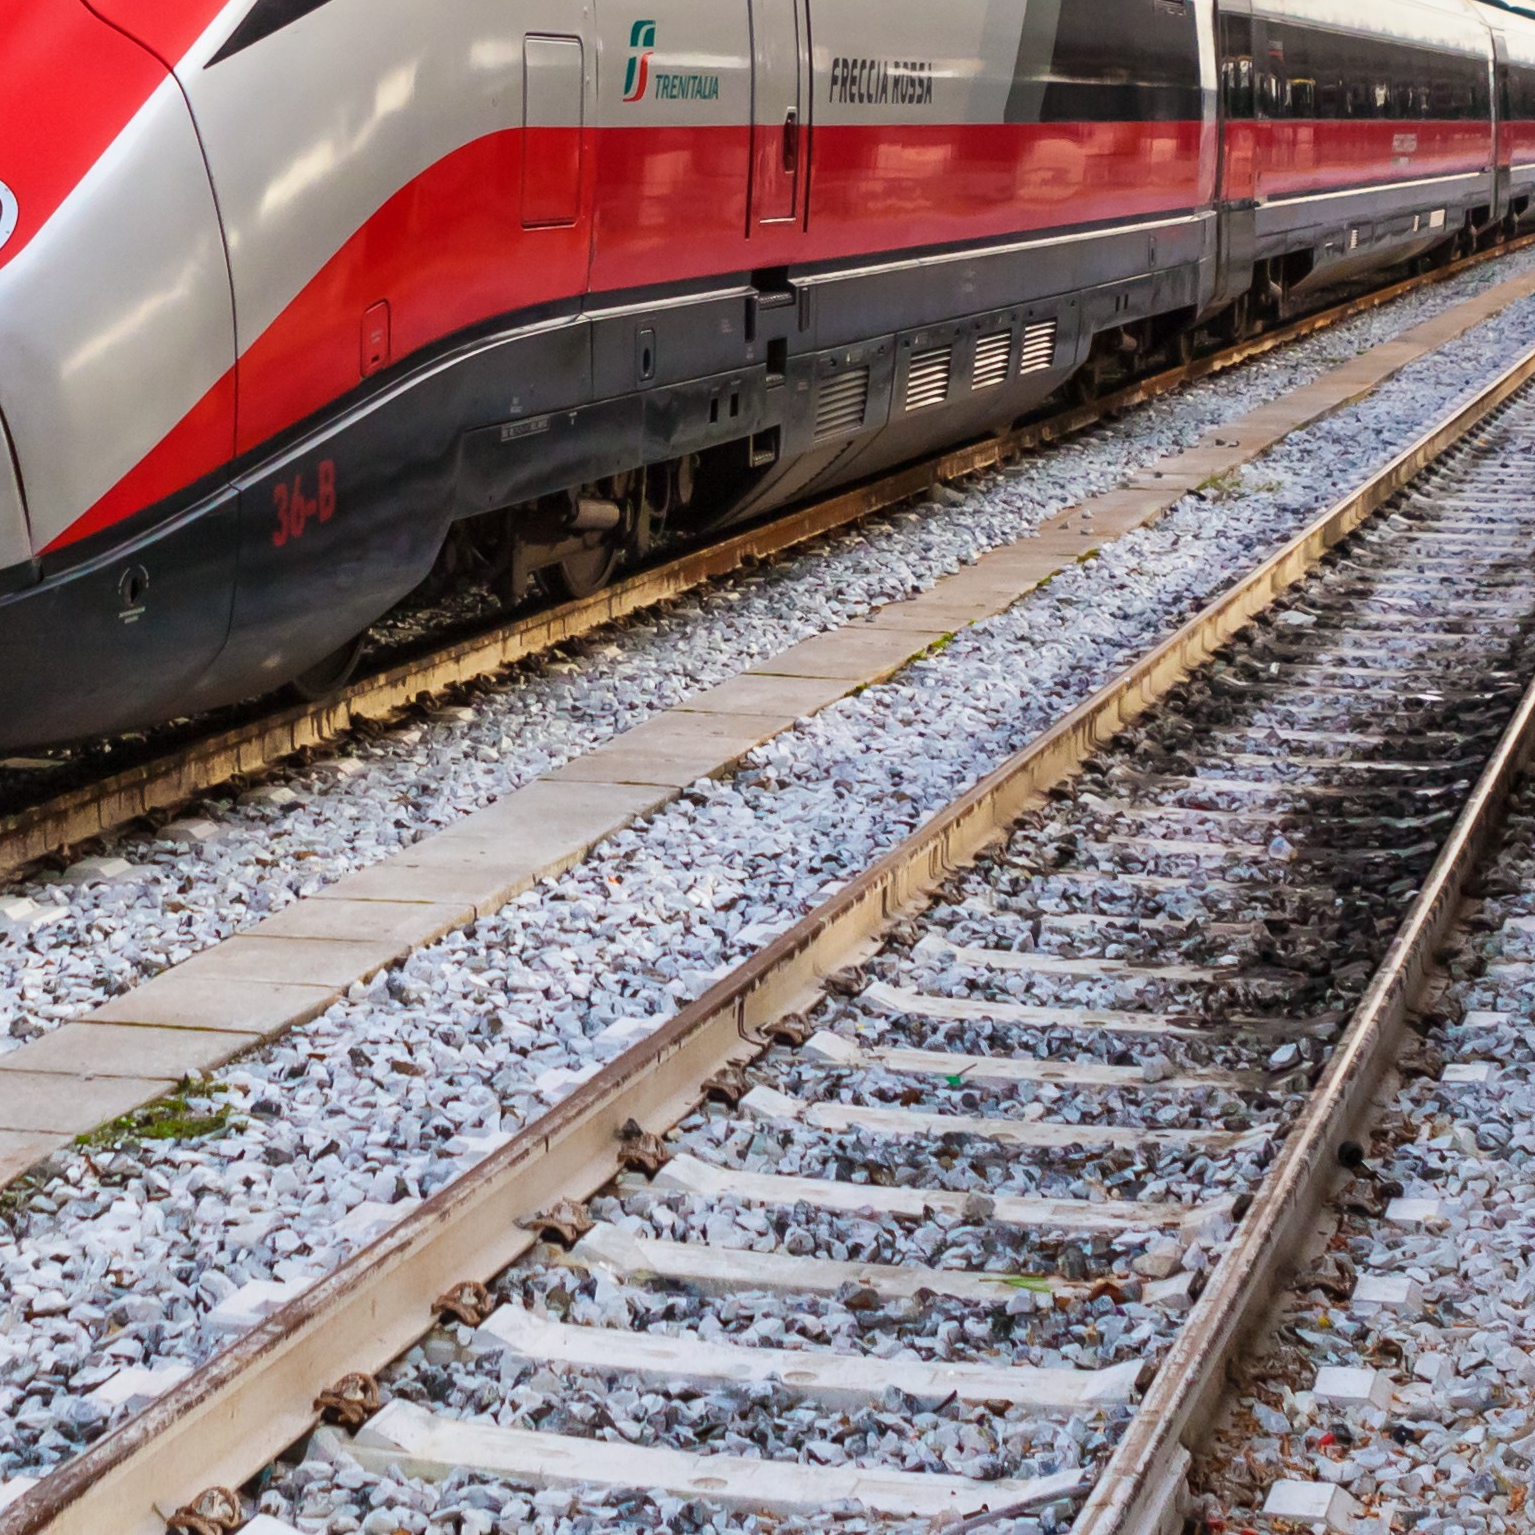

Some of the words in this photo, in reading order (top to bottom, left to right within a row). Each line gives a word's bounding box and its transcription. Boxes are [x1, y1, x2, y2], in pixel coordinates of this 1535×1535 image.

[655, 73, 719, 100] TRENITALIA
[829, 57, 888, 105] FRECCIA
[890, 61, 933, 105] ROSSA
